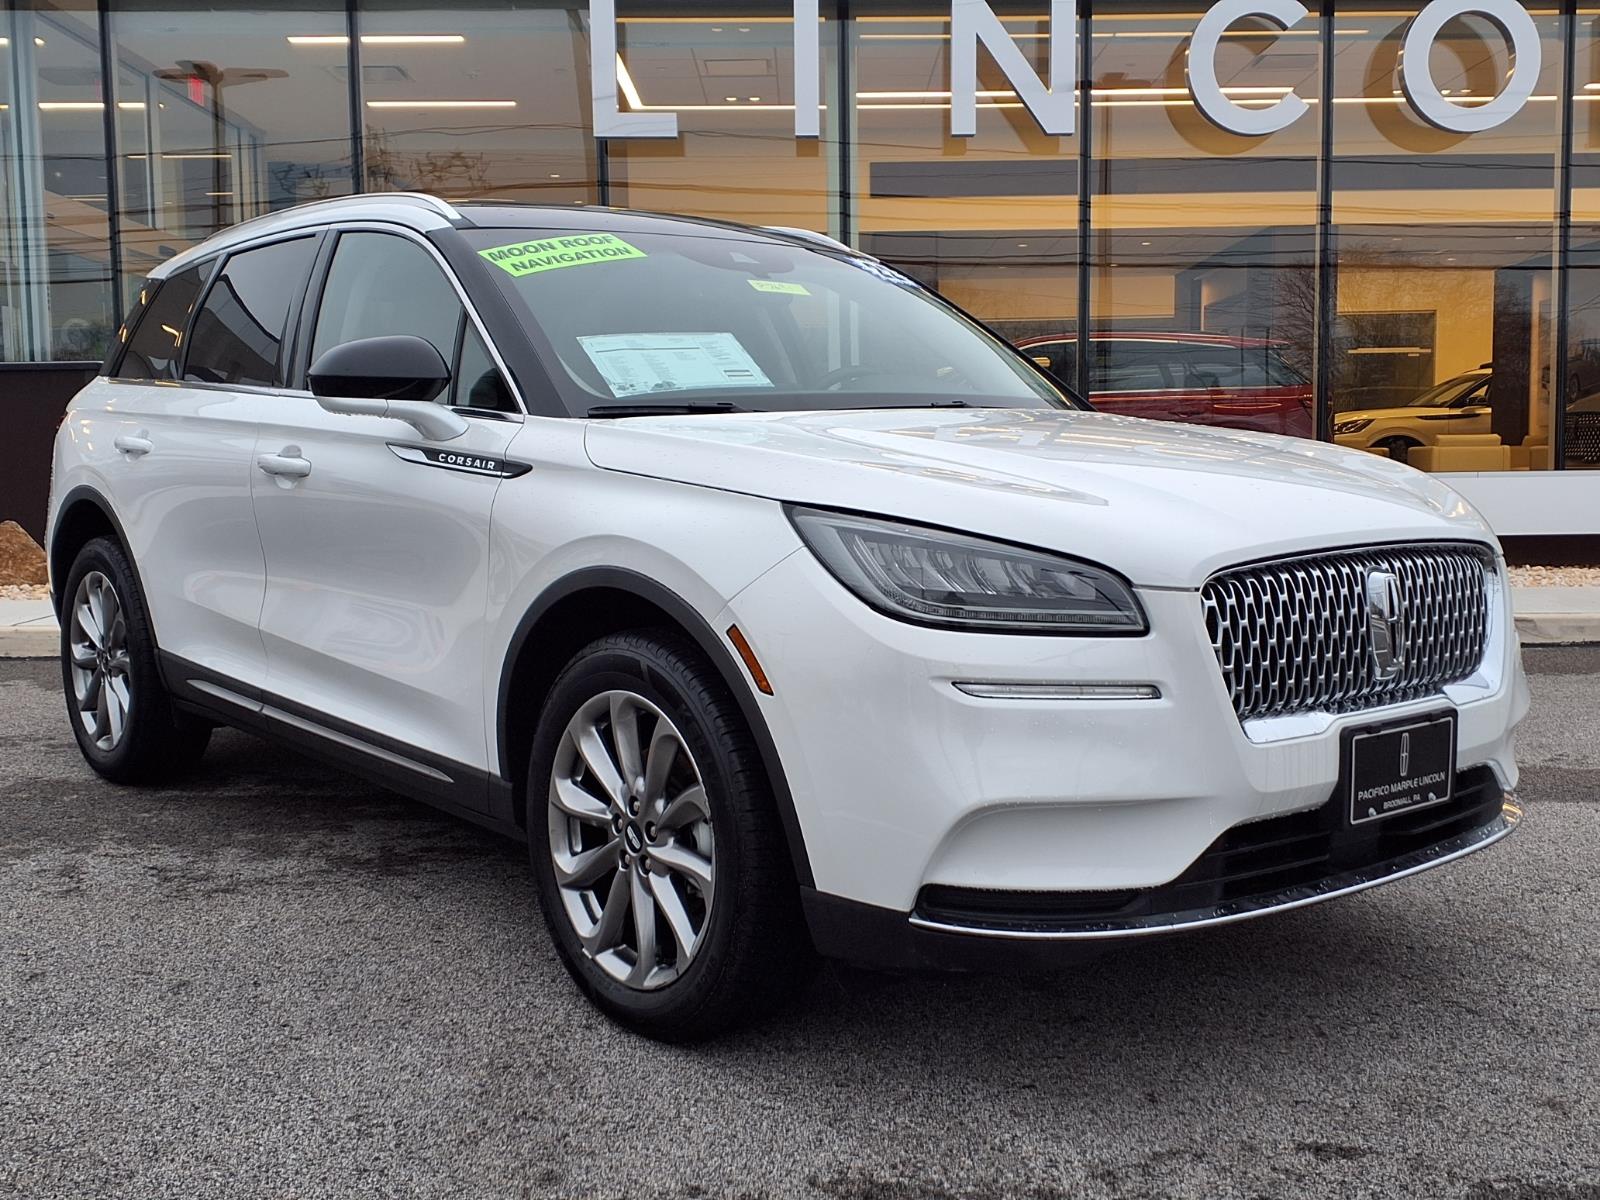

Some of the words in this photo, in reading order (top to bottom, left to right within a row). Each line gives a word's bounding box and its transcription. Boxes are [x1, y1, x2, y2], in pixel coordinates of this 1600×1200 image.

[487, 241, 558, 262] MOON
[558, 234, 616, 249] ROOF
[510, 246, 632, 272] NAVIGATION
[438, 453, 495, 469] CORSAIR
[1358, 785, 1389, 800] PACIFICO
[1391, 778, 1418, 792] MARPLE
[1419, 772, 1445, 785] LINCOLN
